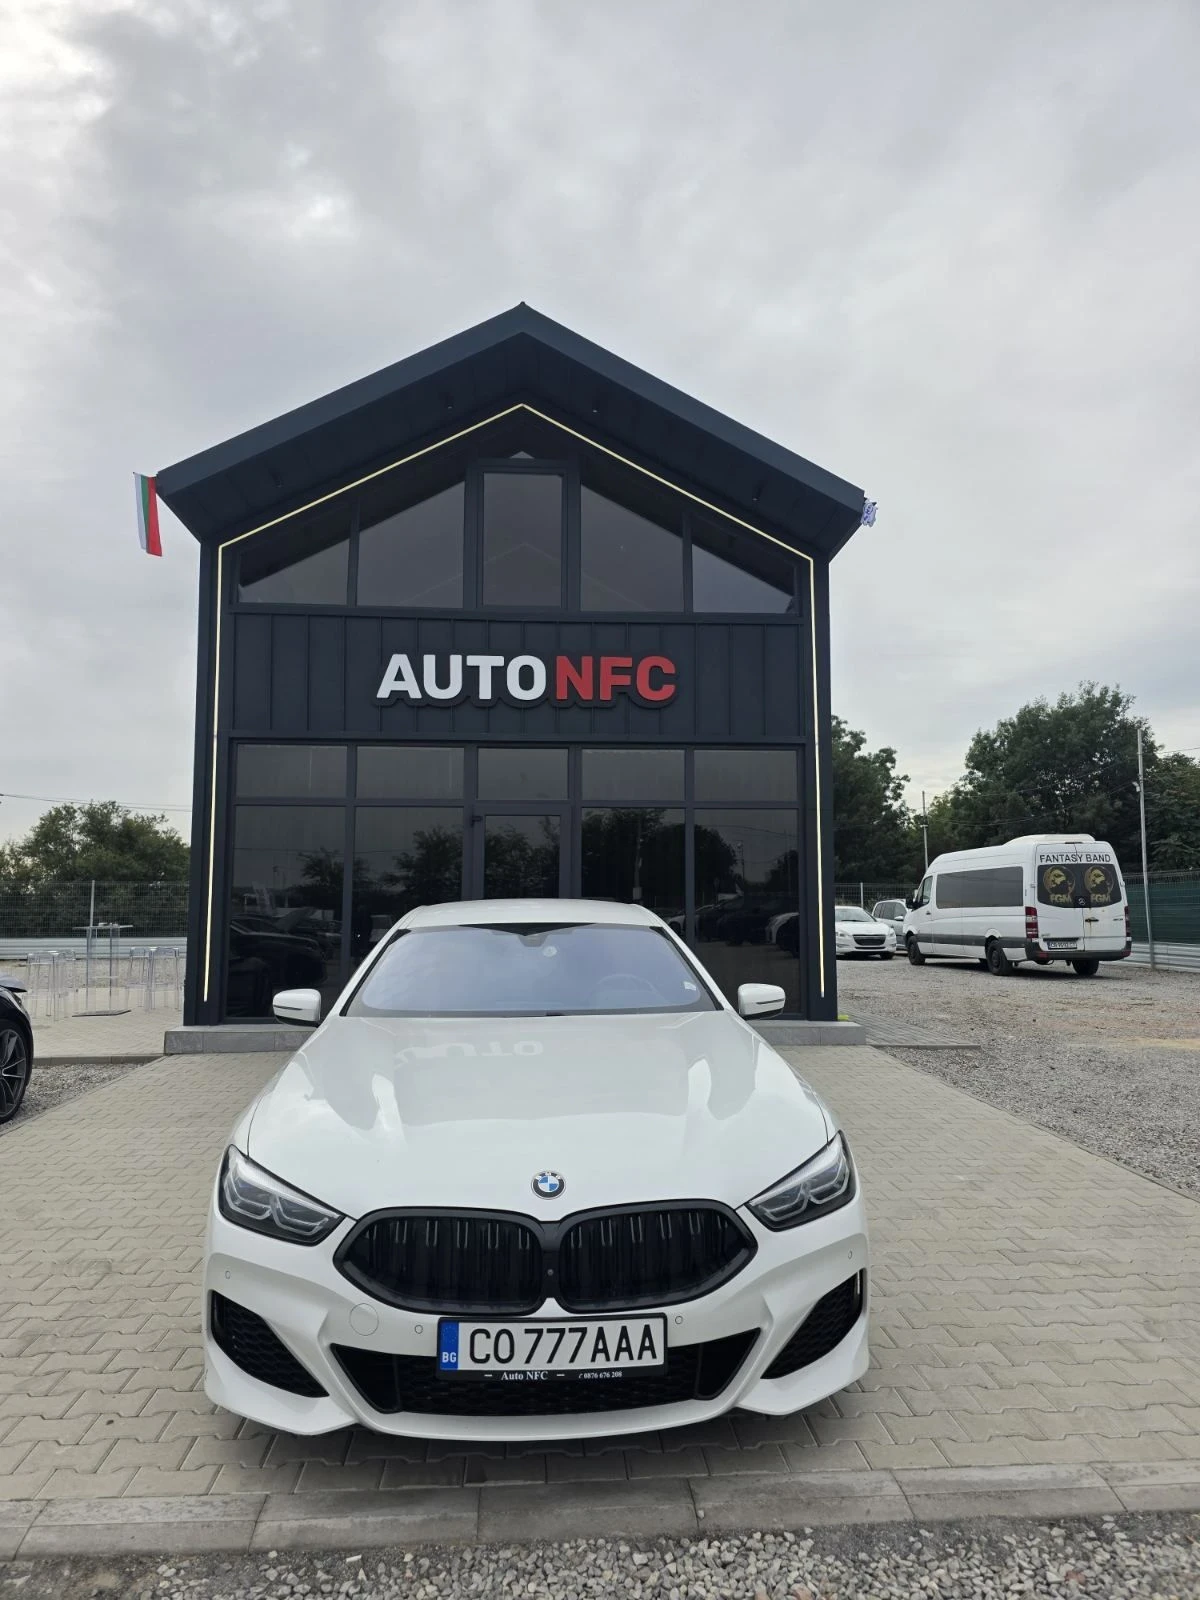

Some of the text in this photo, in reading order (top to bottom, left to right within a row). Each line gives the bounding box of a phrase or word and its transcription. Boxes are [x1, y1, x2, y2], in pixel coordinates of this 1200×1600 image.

[1039, 853, 1111, 863] FANTASY BAND
[441, 1352, 457, 1363] BG
[501, 1371, 548, 1380] Auto NFC
[599, 1371, 611, 1379] 676
